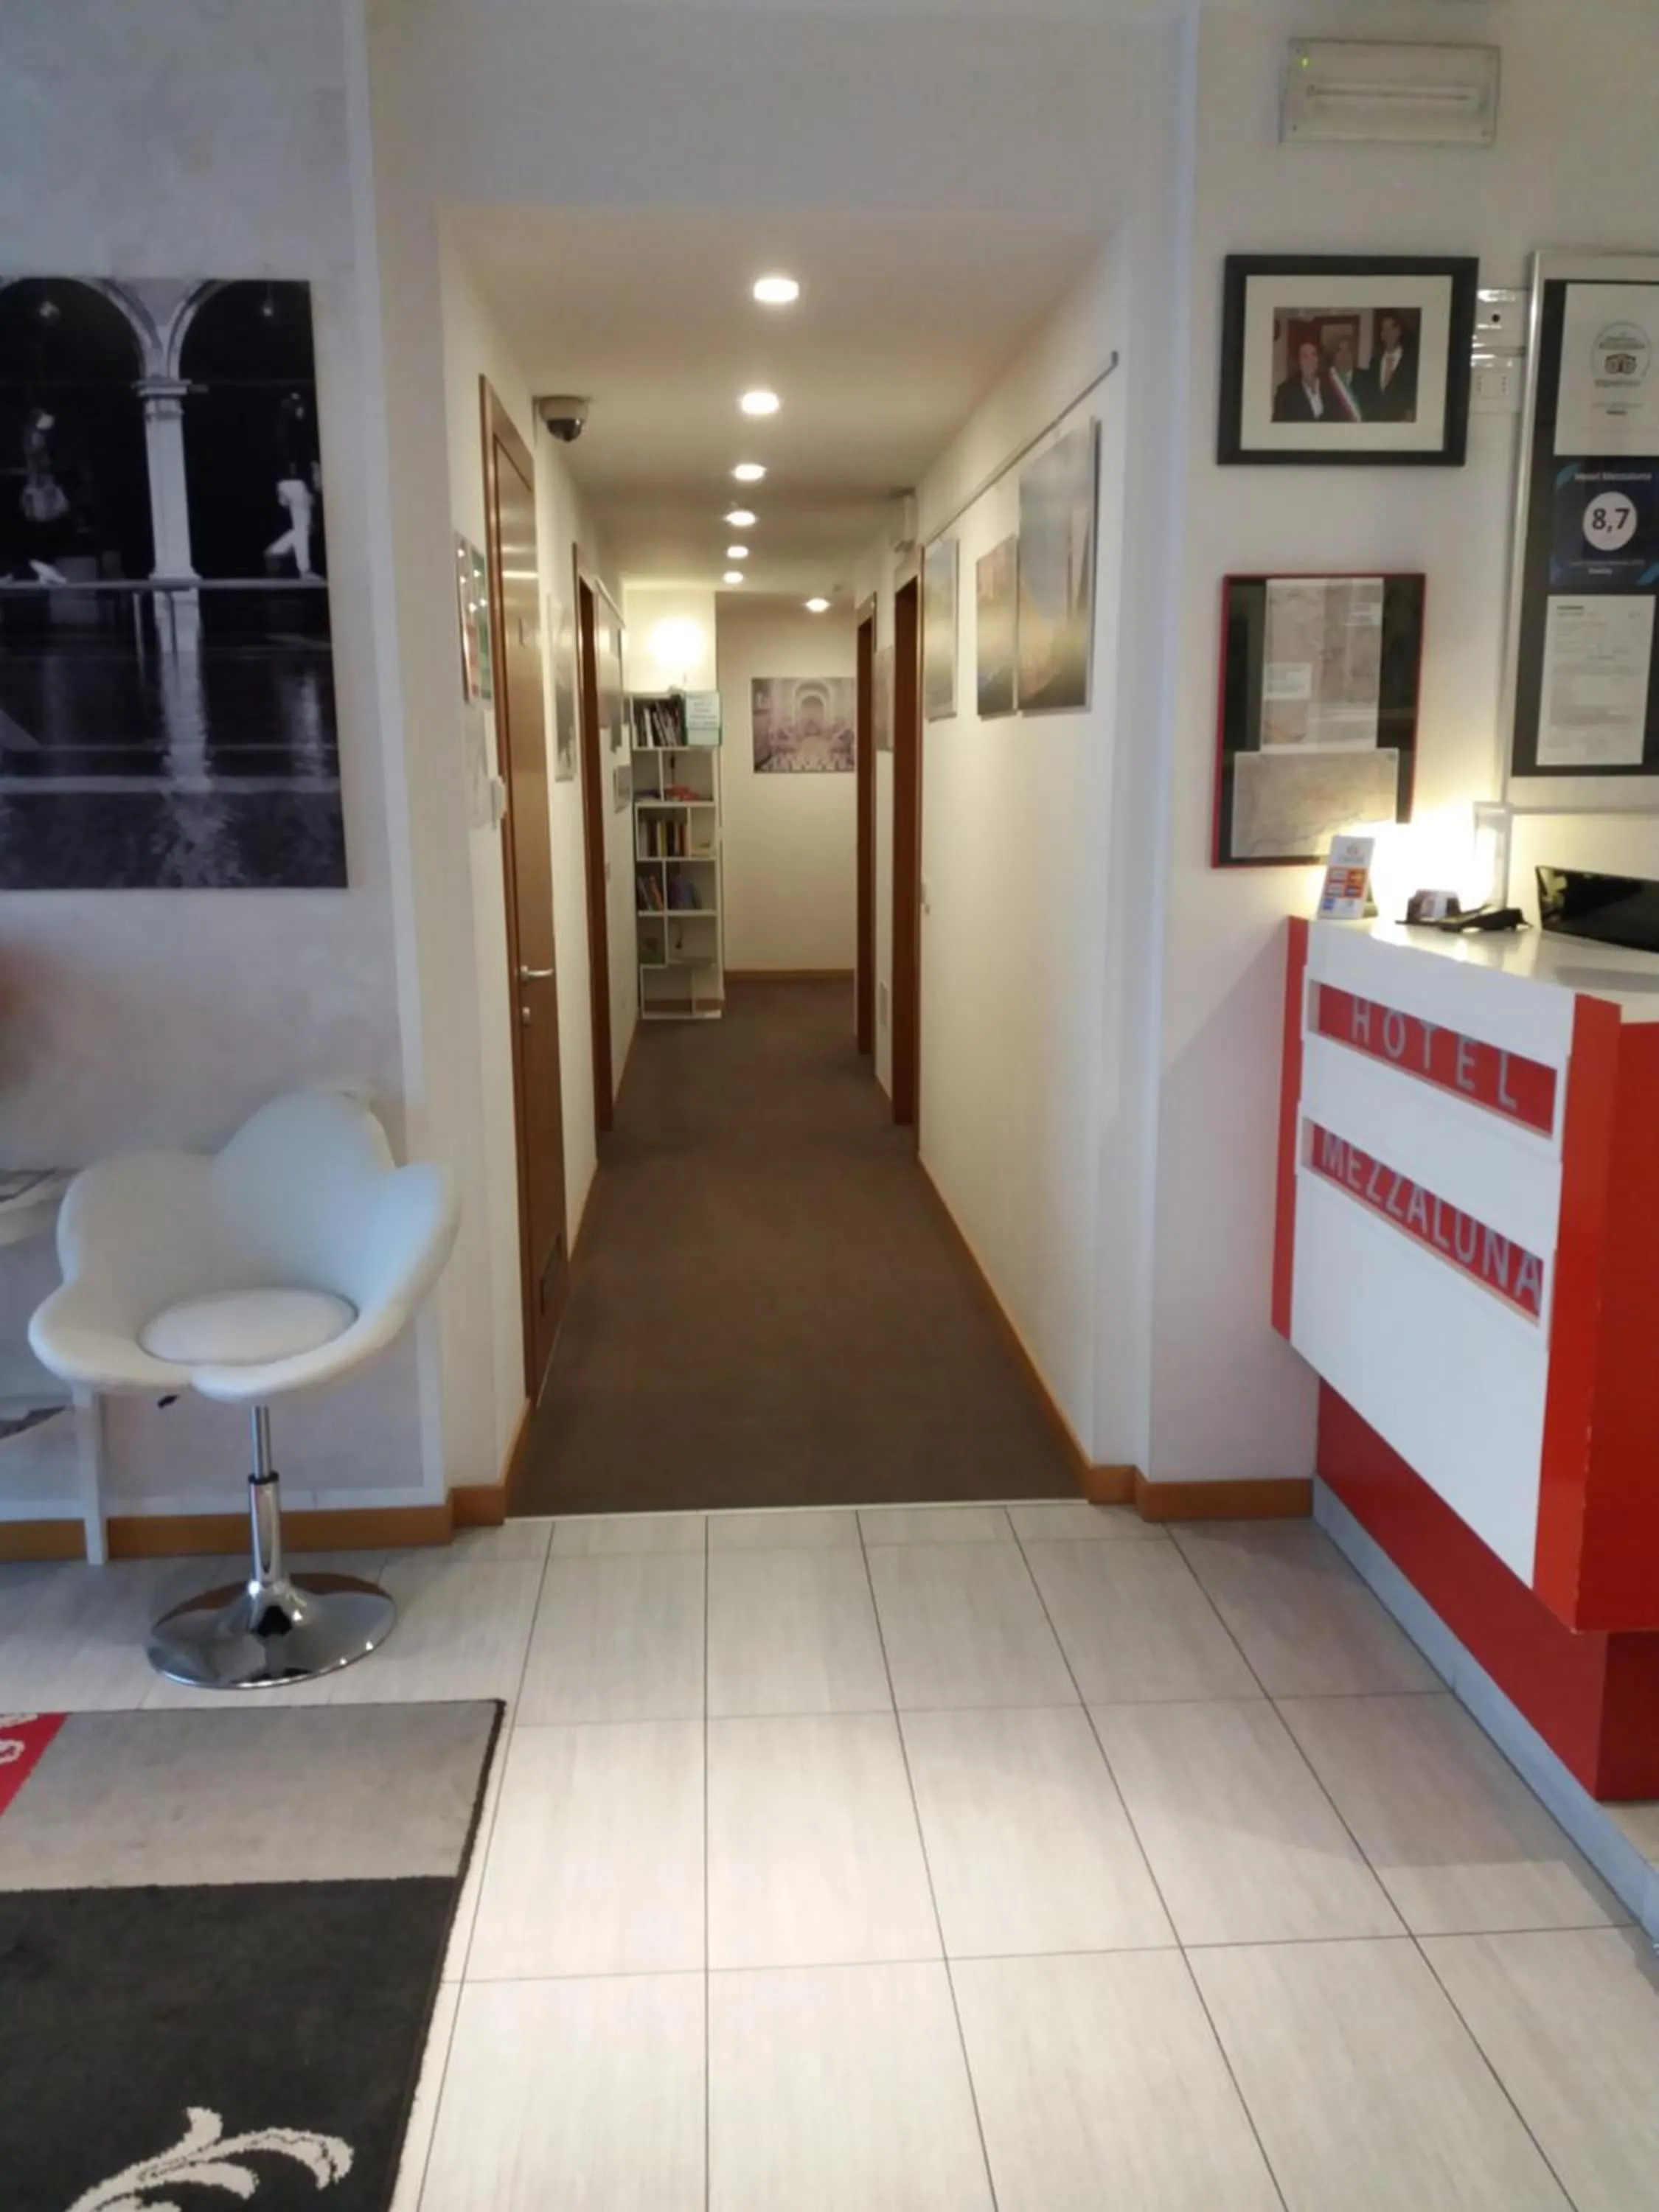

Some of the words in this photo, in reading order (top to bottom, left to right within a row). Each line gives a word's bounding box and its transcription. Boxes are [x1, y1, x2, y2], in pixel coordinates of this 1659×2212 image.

[1592, 507, 1630, 533] 8,7
[1352, 995, 1517, 1110] HOTEL
[1324, 1130, 1543, 1316] MEZZALUNA
